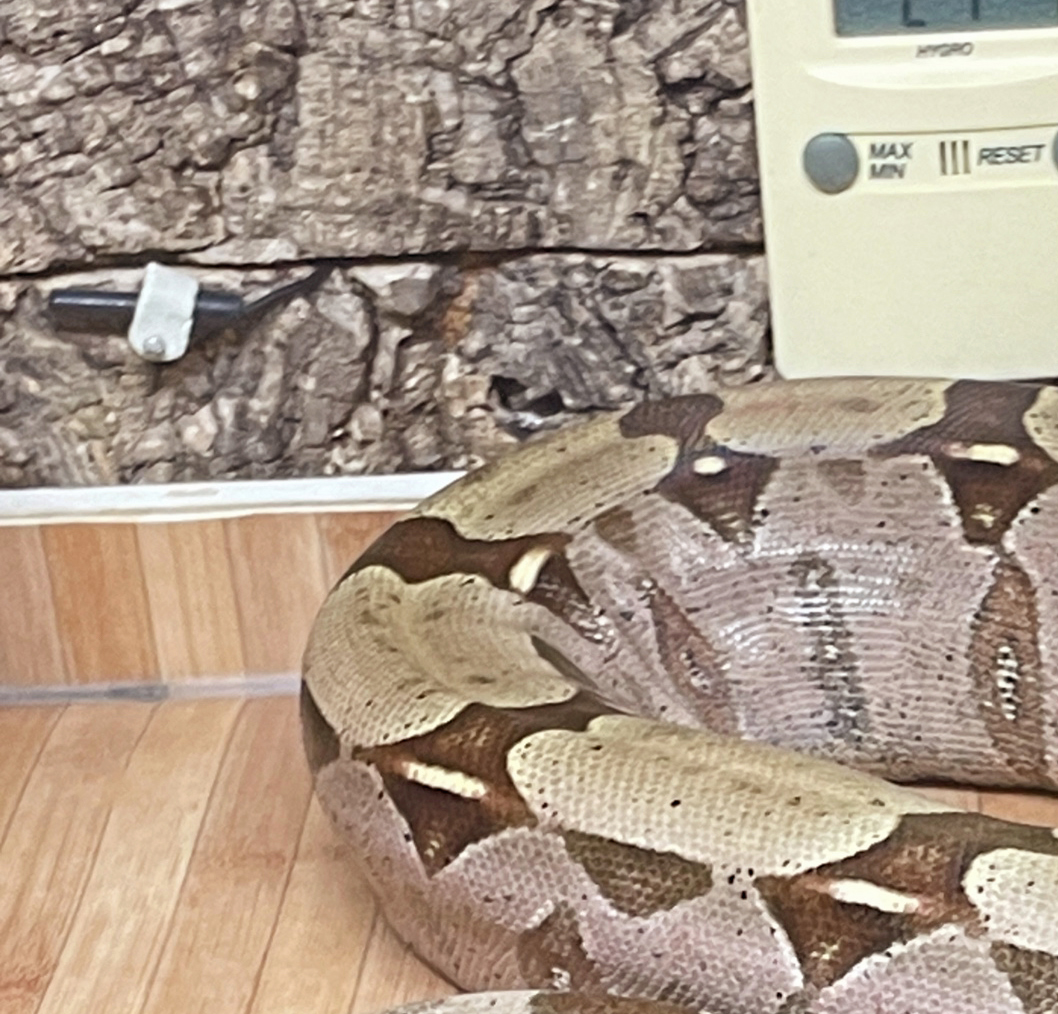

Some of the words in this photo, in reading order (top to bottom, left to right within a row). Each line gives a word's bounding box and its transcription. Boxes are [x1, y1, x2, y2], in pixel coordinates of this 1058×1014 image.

[916, 42, 974, 58] HYGRO
[869, 143, 913, 160] MAX
[977, 144, 1046, 166] RESET
[869, 163, 907, 180] MIN
